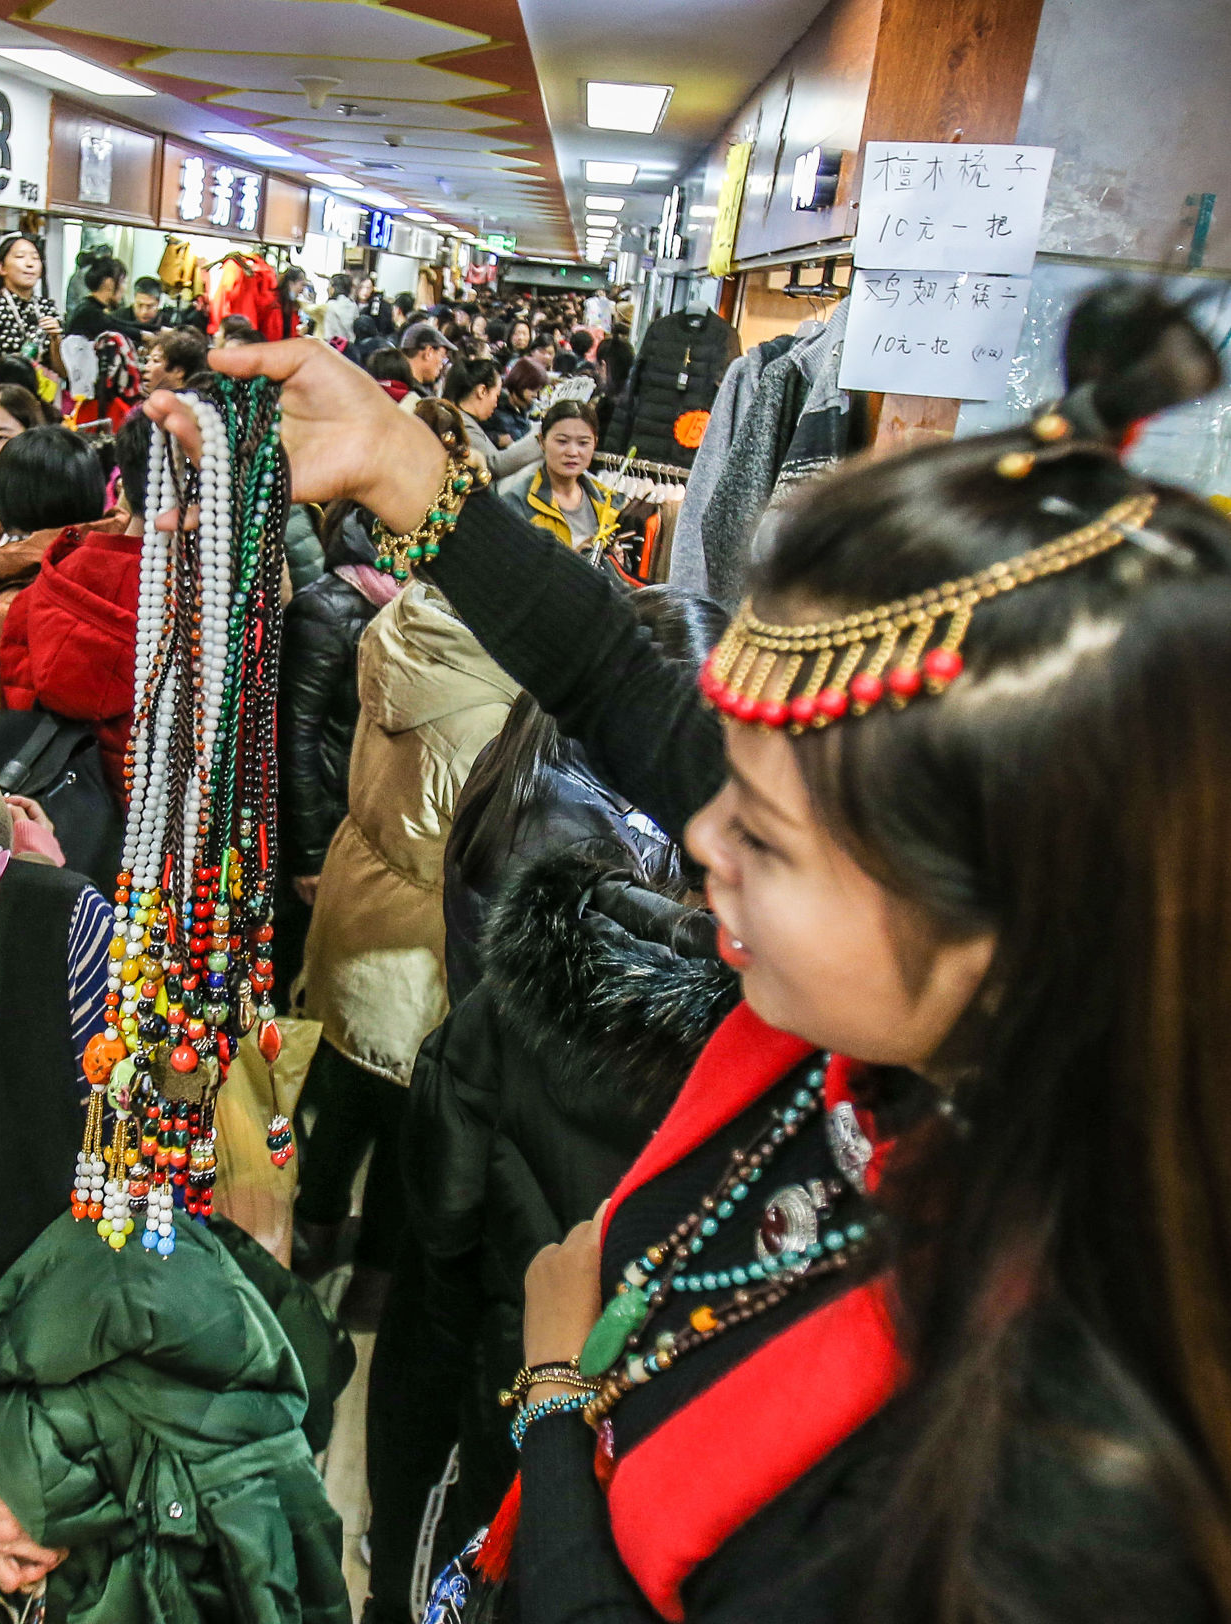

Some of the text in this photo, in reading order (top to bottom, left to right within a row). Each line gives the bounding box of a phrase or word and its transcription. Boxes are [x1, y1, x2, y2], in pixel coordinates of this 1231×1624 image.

[878, 213, 1013, 243] 10元一把
[871, 334, 951, 357] 10元一把
